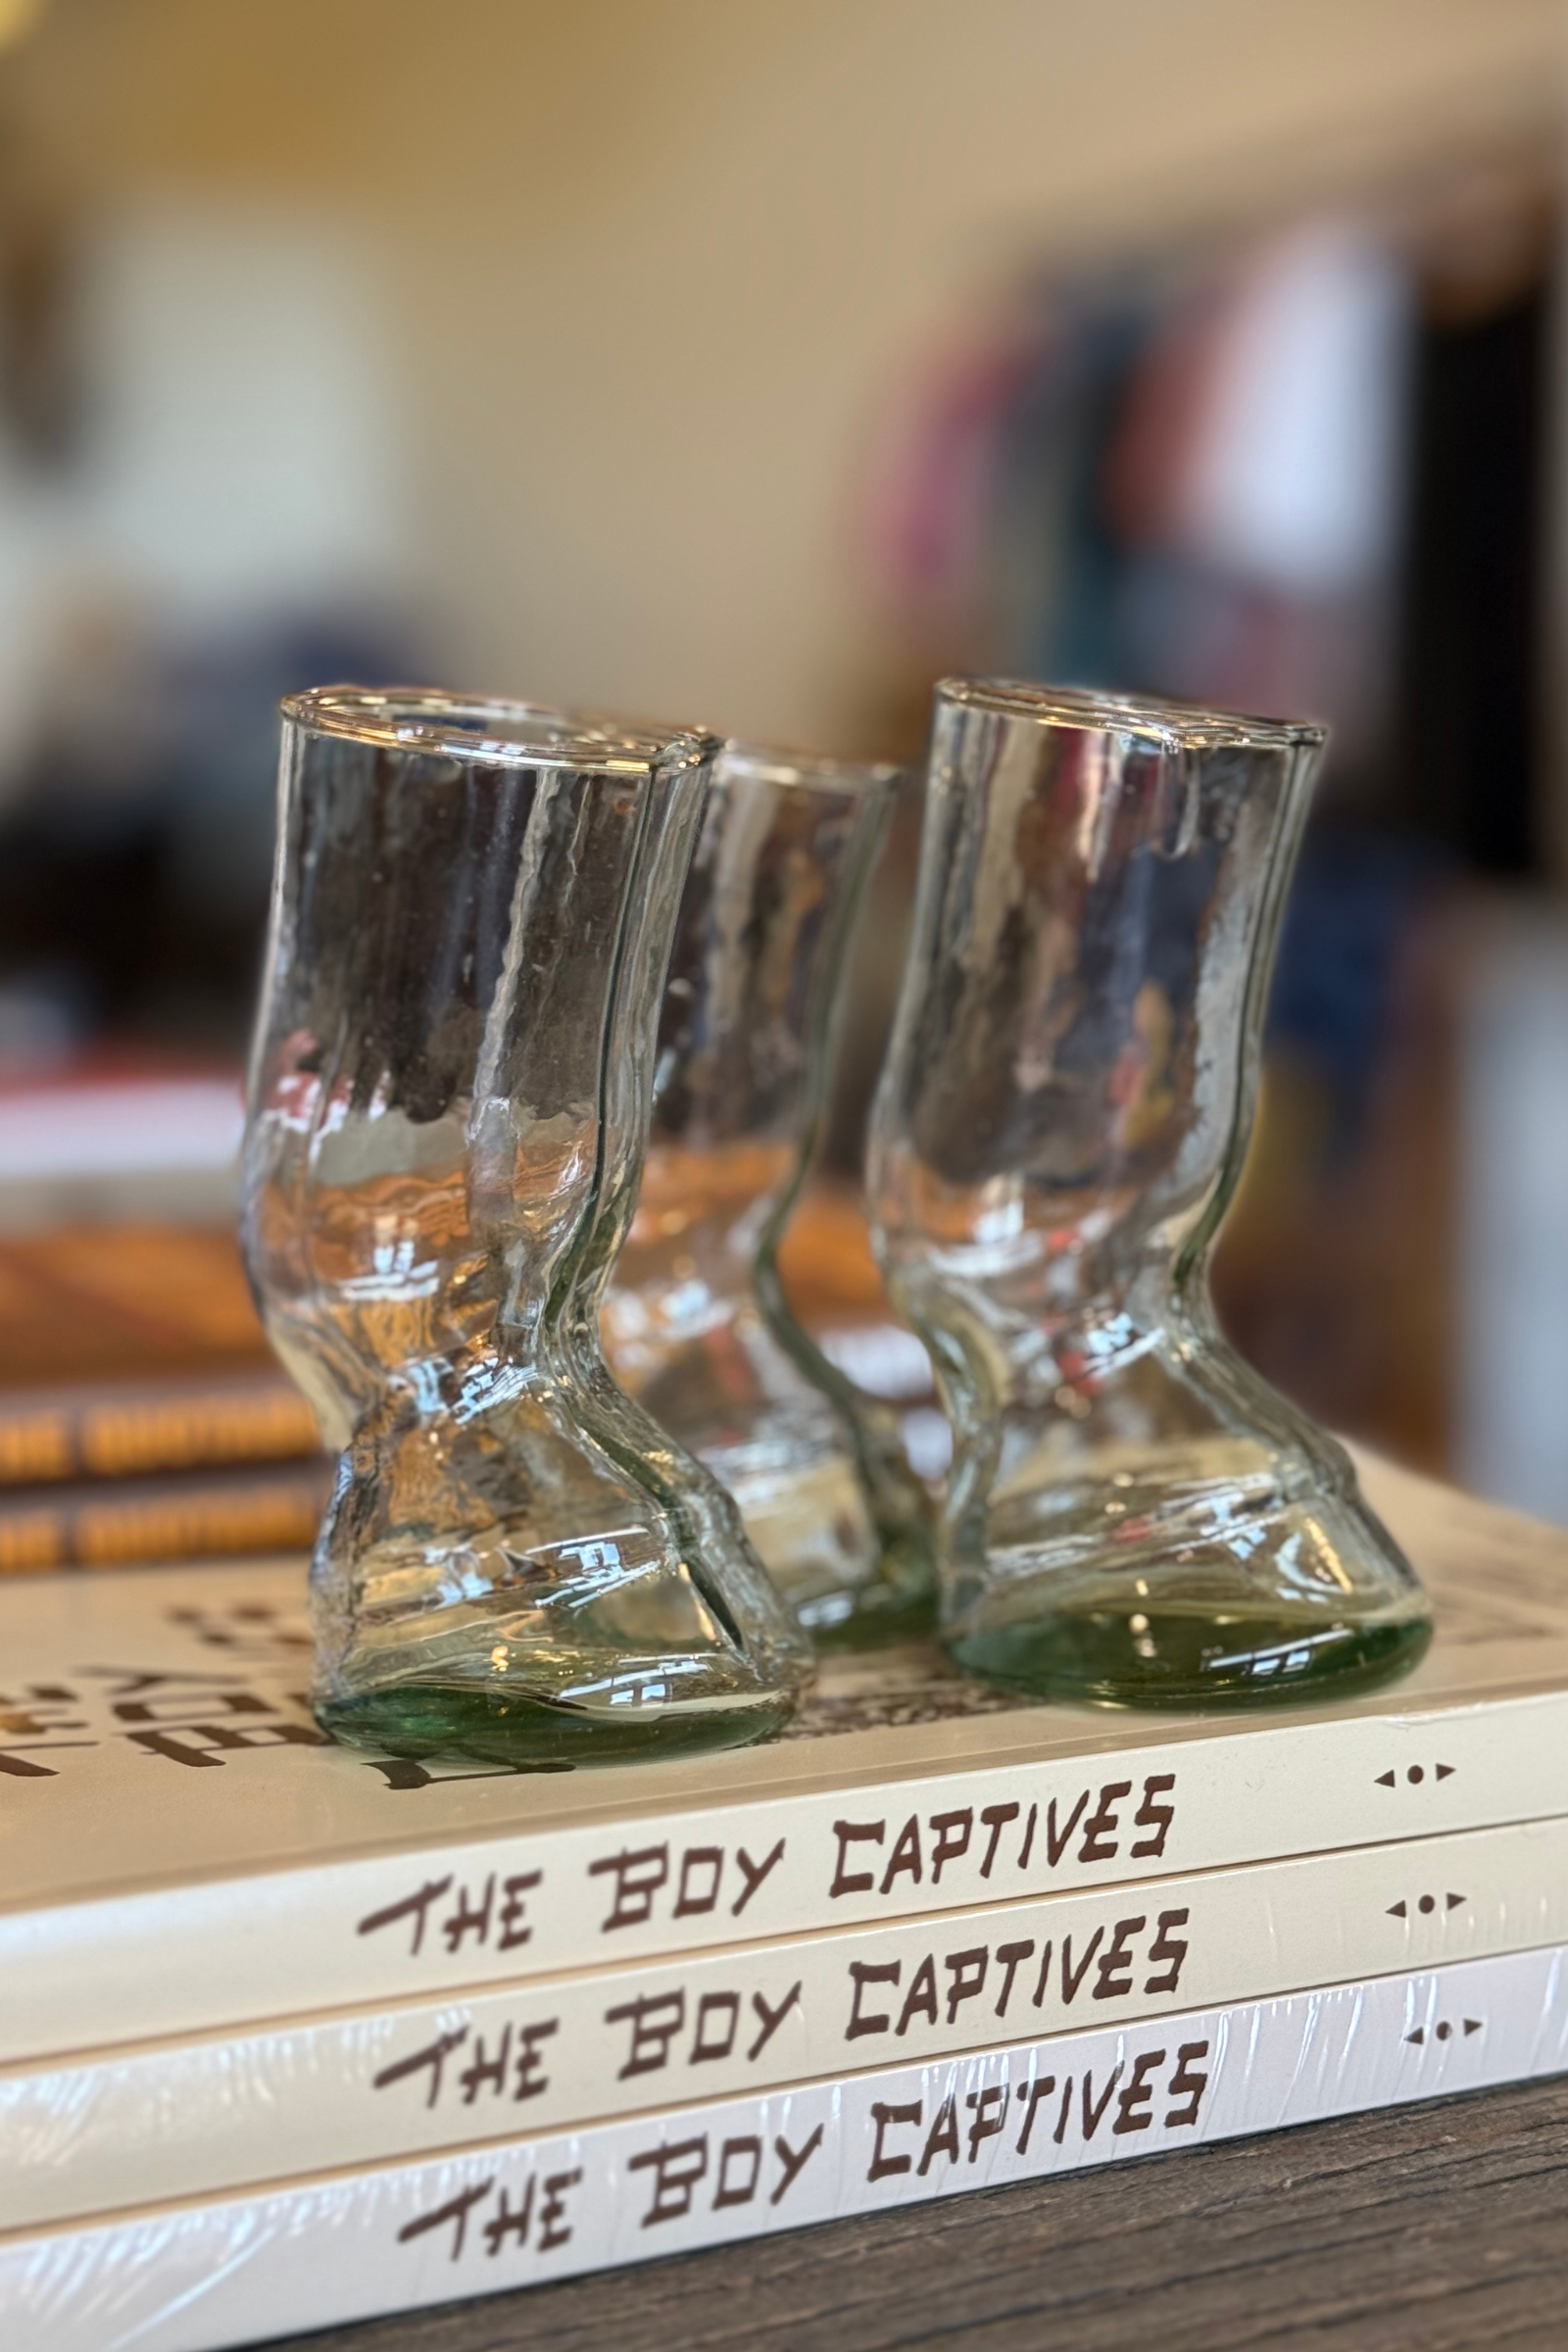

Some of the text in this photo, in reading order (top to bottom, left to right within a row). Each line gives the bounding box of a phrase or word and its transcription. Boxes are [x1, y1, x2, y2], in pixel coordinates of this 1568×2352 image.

[357, 1772, 1177, 1956] THE BOY CAPTIVES
[372, 1906, 1191, 2109] THE BOY CAPTIVES
[396, 2038, 1210, 2263] THE BOY CAPTIVES
